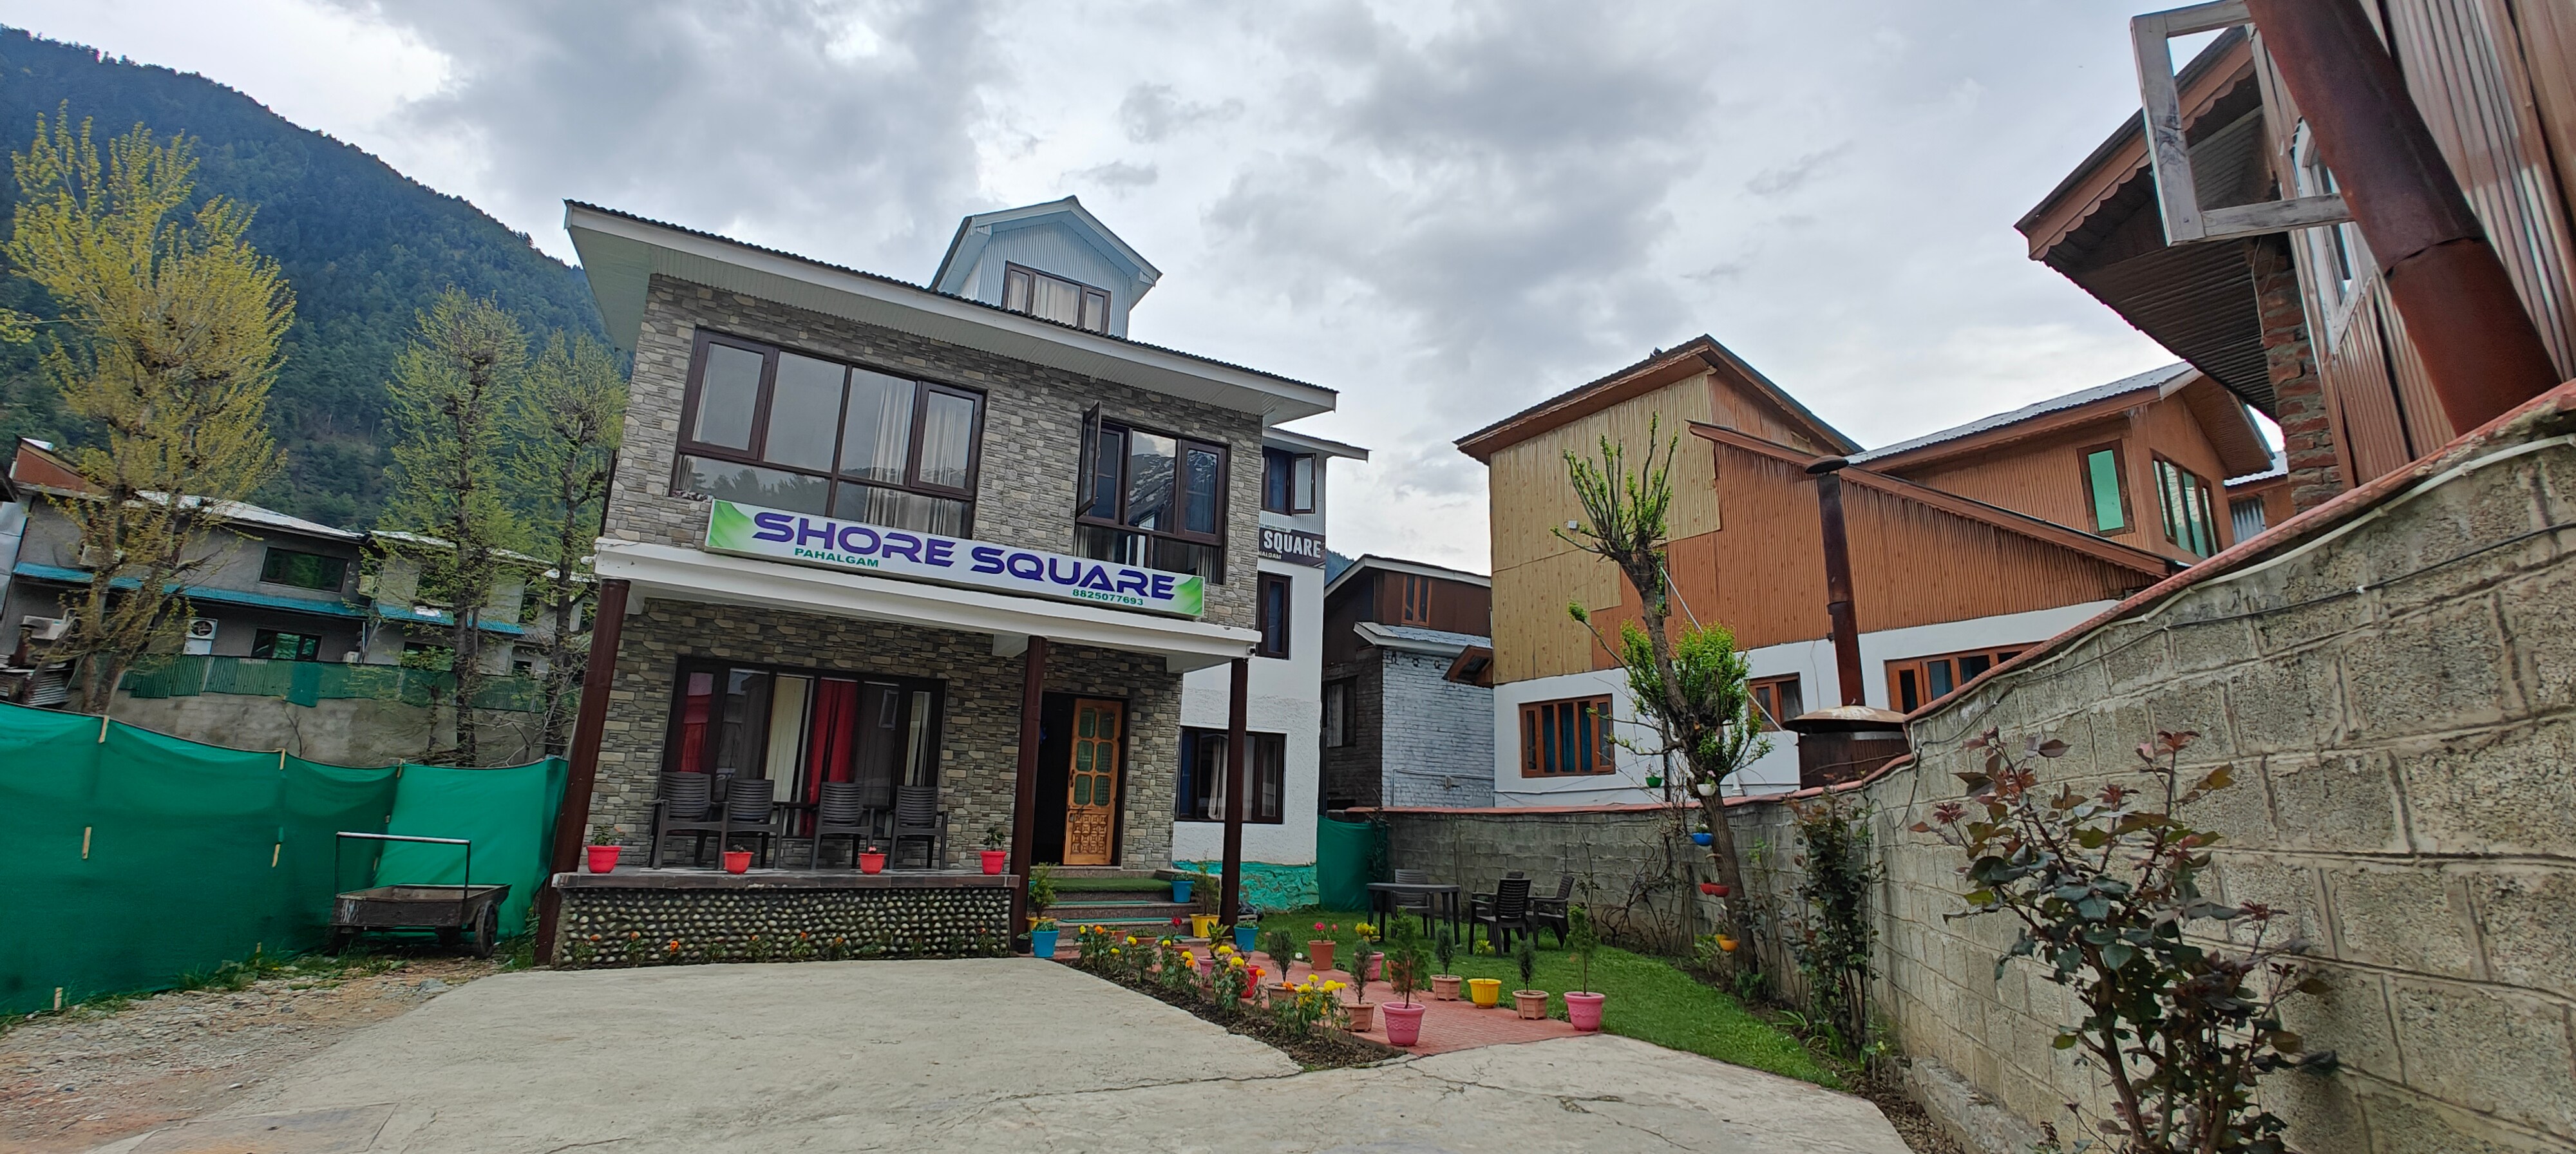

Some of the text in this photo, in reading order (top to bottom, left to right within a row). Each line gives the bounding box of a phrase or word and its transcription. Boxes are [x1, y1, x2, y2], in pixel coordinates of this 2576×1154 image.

[752, 512, 1175, 600] SHORE SQUARE
[1264, 530, 1321, 559] SQUARE
[794, 547, 879, 567] PAHALGAM
[1072, 589, 1143, 605] 8825077693
